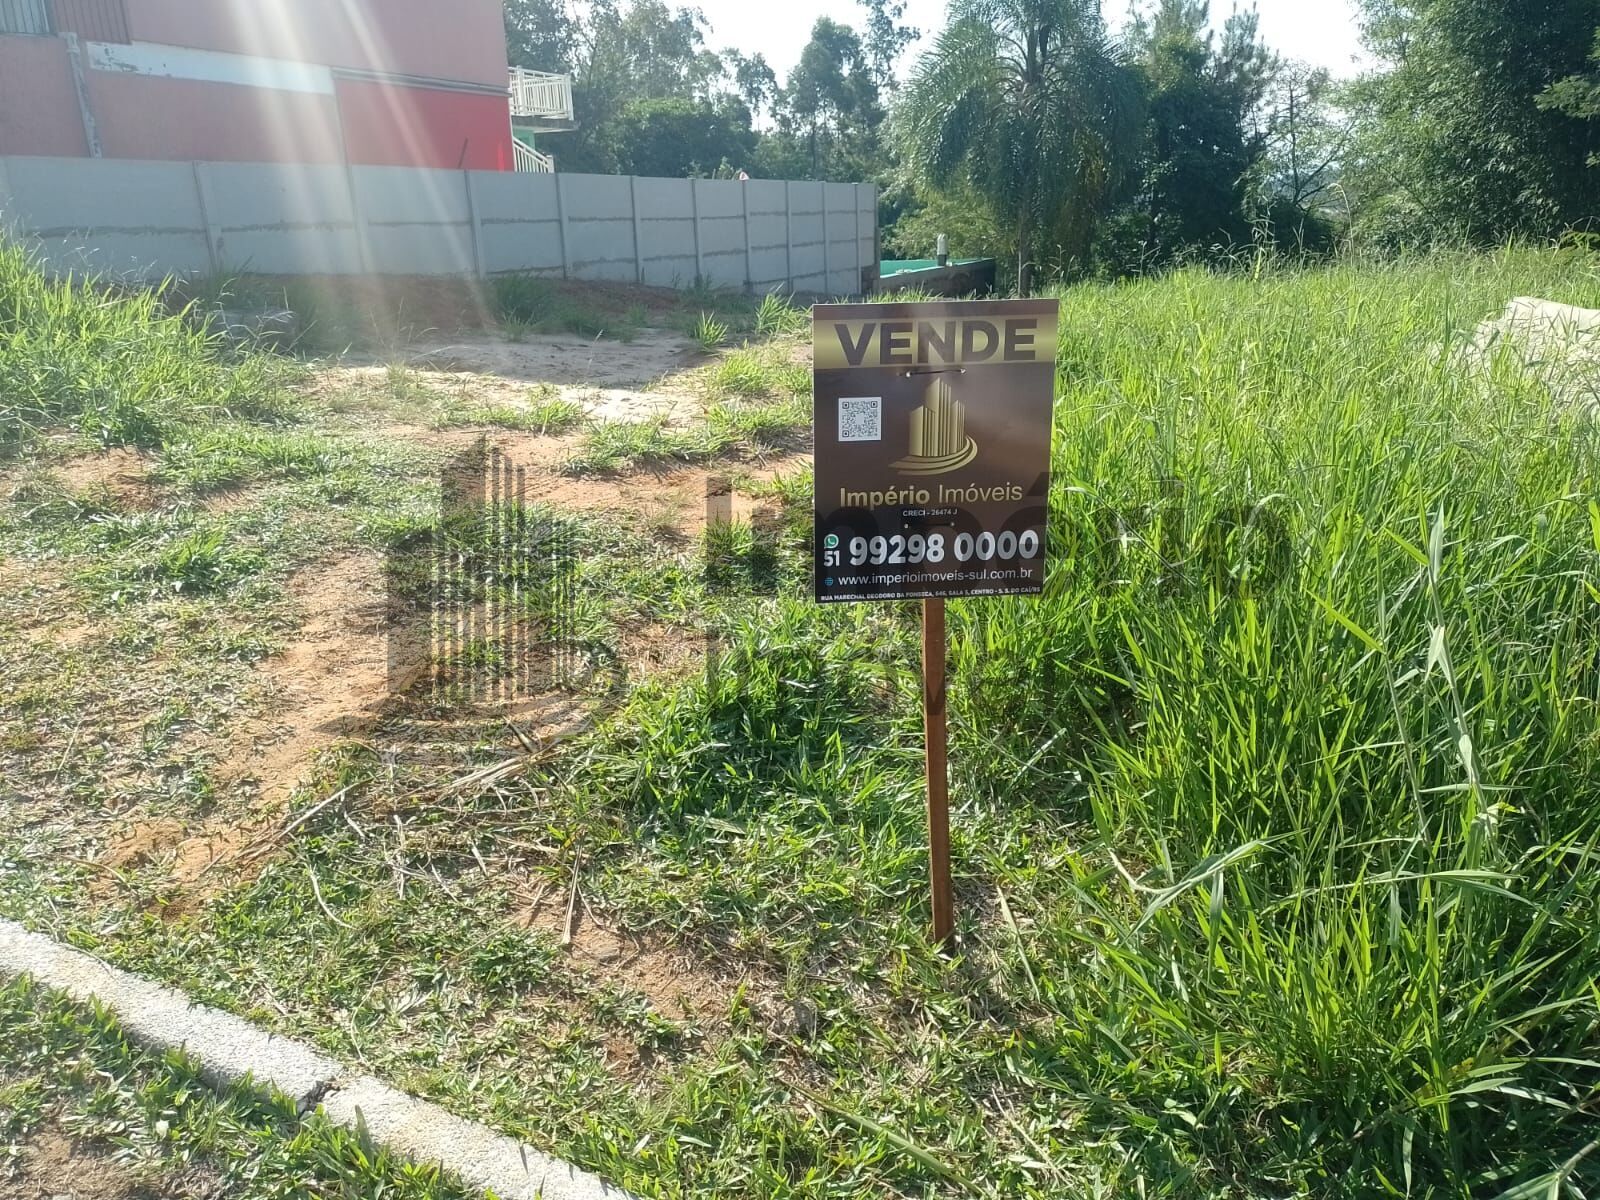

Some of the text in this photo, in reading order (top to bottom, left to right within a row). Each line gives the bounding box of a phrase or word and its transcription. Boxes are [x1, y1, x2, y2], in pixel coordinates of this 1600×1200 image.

[834, 318, 1038, 366] VENDE
[840, 481, 1023, 510] Império Imóveis
[902, 508, 926, 517] CRECI
[931, 508, 952, 516] 26474
[823, 550, 840, 567] 51
[849, 529, 1039, 566] 99298 0000
[838, 567, 1033, 586] www.imperioimoveis-sul.com.br
